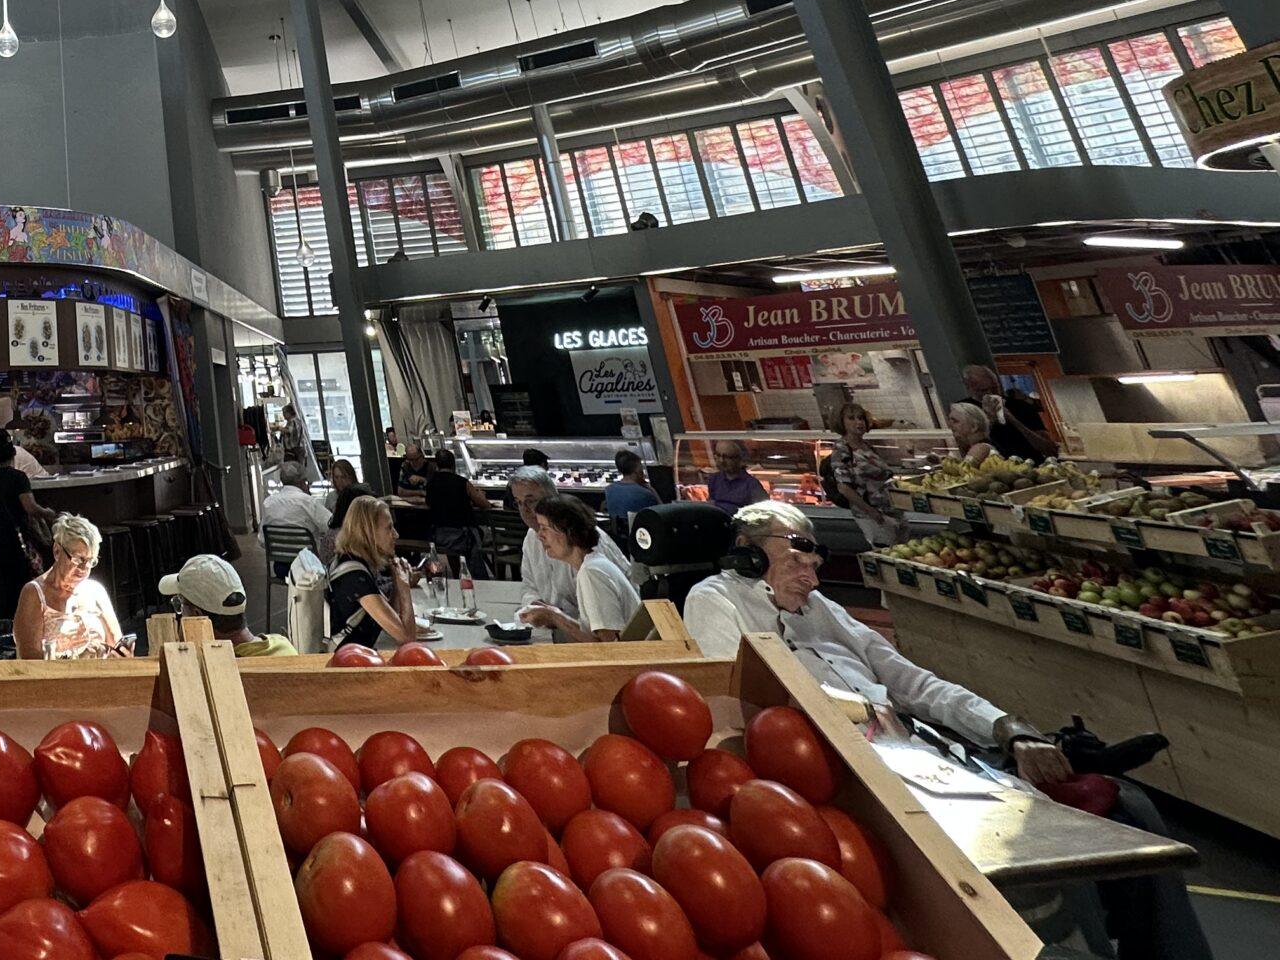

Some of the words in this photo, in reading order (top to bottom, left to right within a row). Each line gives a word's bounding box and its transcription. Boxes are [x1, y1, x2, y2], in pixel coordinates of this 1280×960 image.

[1174, 81, 1266, 134] Chez
[1177, 275, 1228, 300] Jean
[743, 306, 800, 328] Jean
[808, 291, 908, 323] BRUM
[554, 330, 583, 349] LES
[588, 327, 649, 348] GLACES
[747, 336, 779, 347] Artisan
[781, 334, 820, 345] Boucher
[829, 328, 891, 341] Charcuterie
[595, 361, 616, 378] Les
[579, 370, 656, 398] Cigalines
